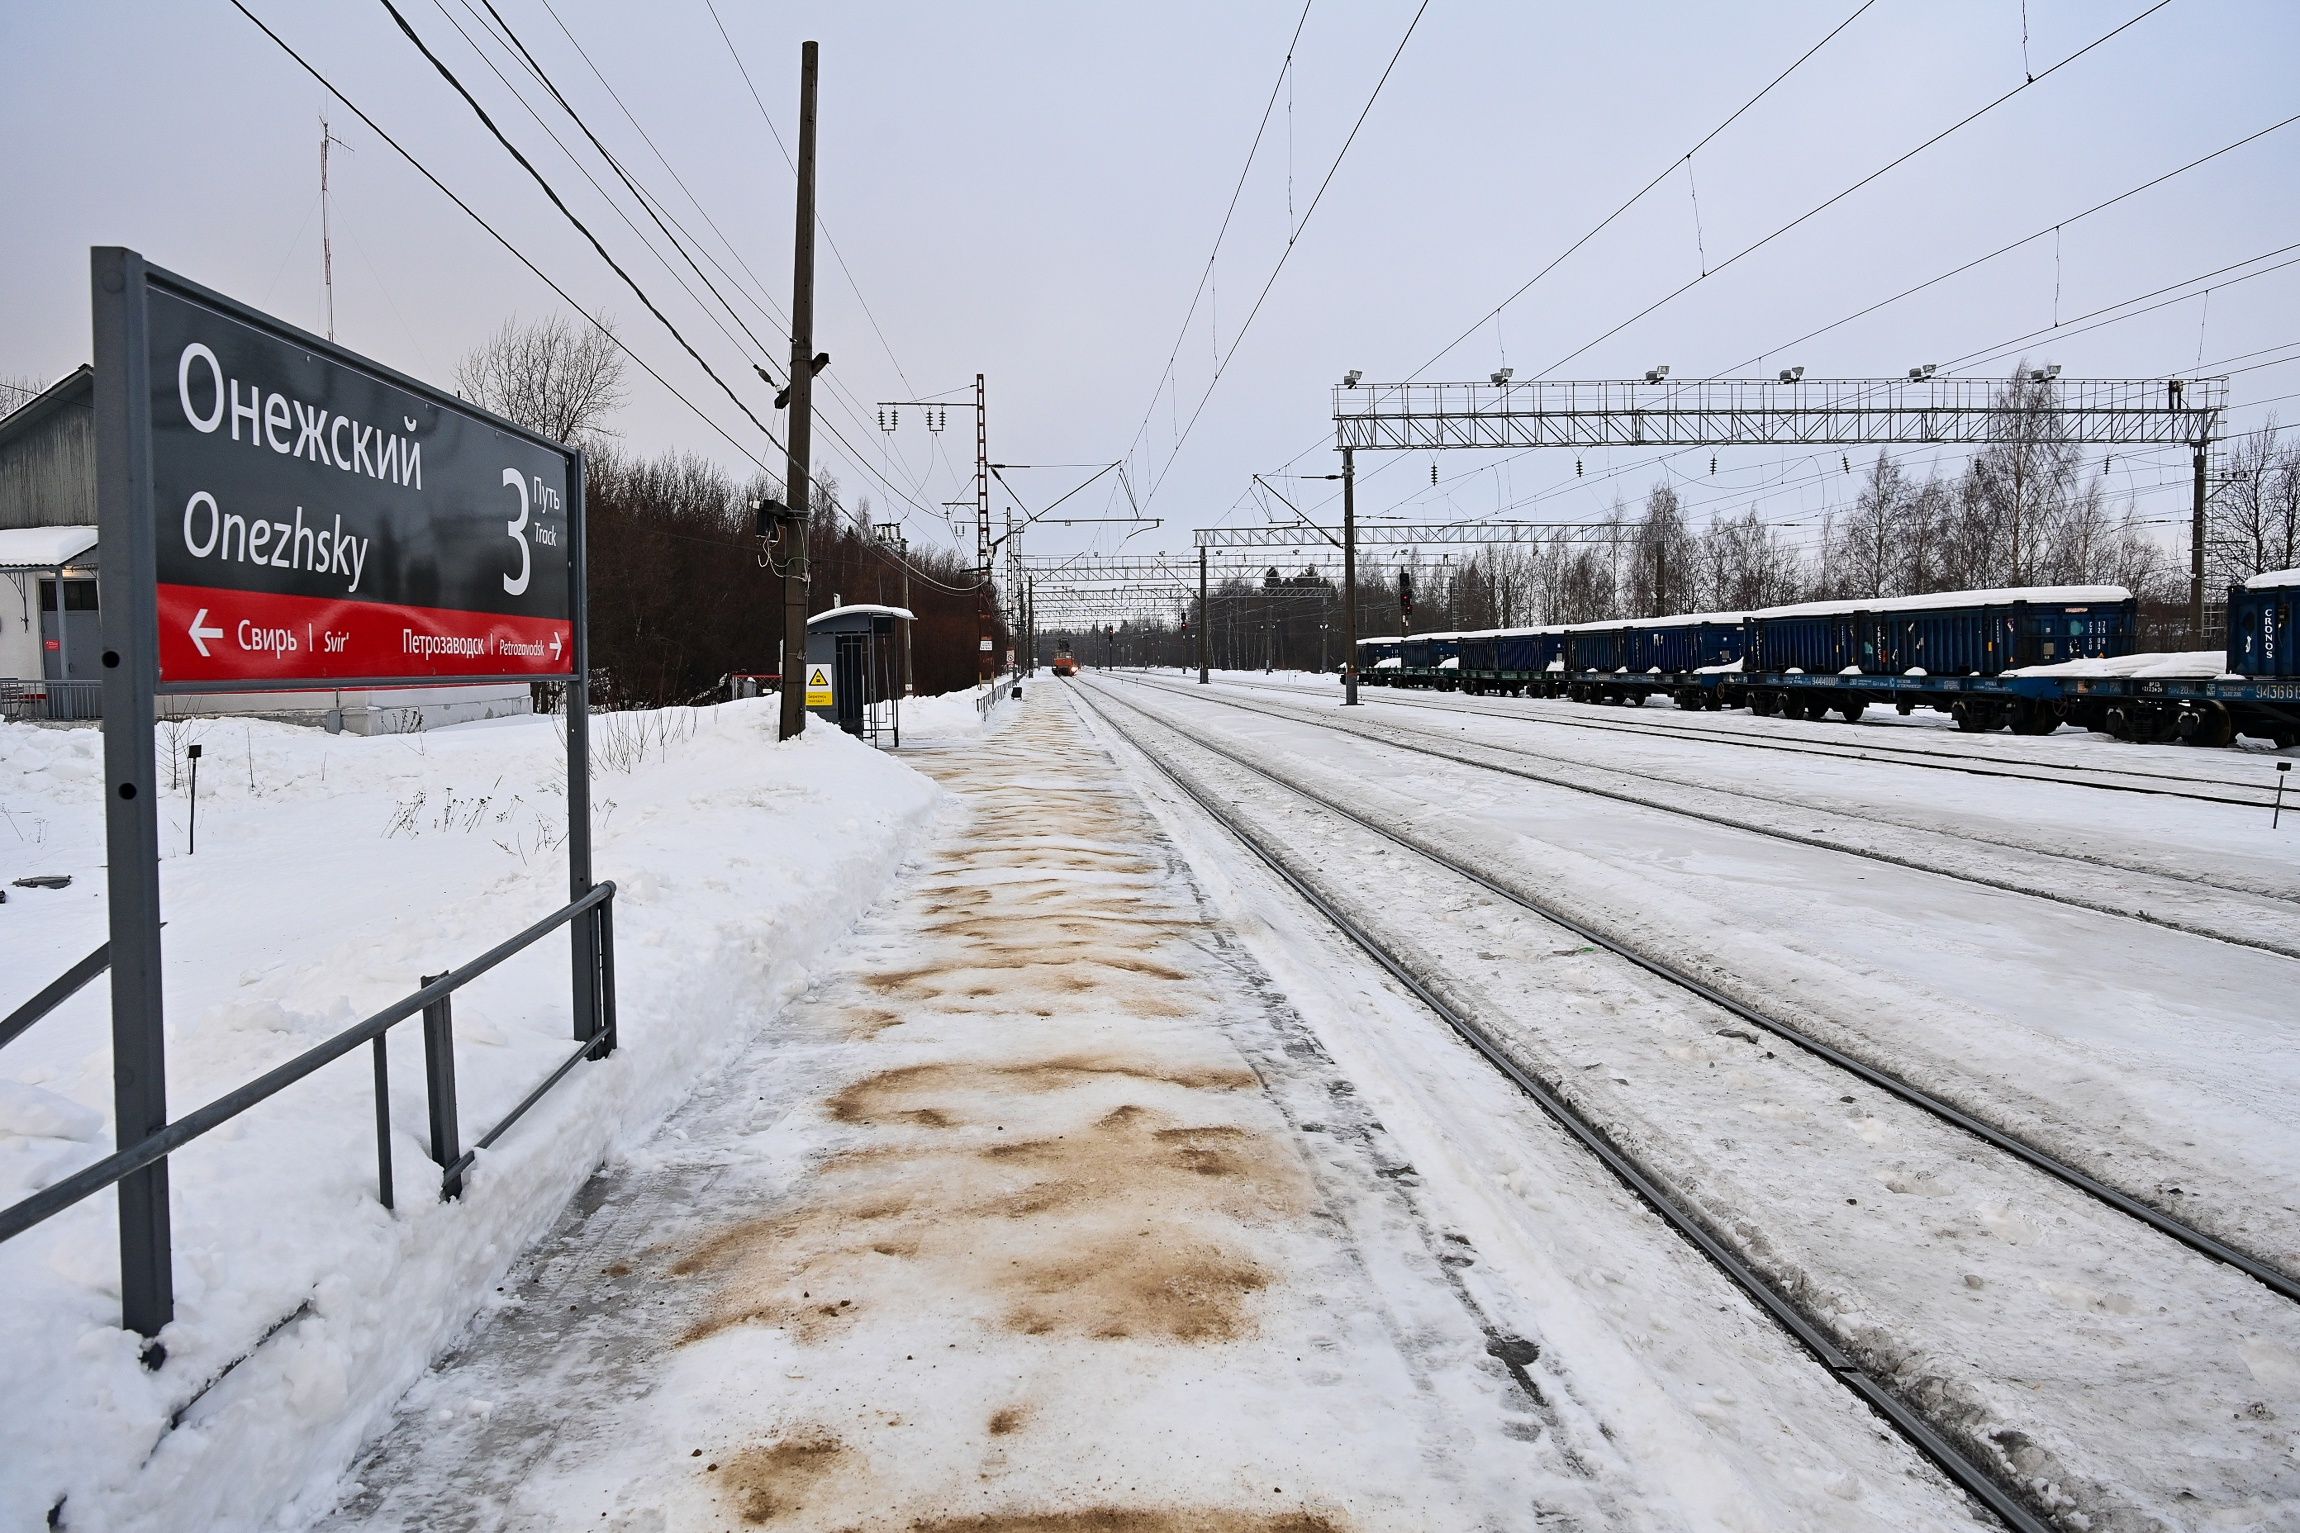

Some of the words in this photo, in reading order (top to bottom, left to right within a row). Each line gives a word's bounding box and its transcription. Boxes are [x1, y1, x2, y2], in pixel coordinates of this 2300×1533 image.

[178, 342, 422, 491] Онежский
[533, 476, 560, 514] Путь
[183, 490, 369, 593] Onezhsky
[502, 467, 531, 596] 3
[534, 522, 557, 547] Track
[237, 619, 298, 659] Свирь
[324, 631, 349, 653] Svir'
[403, 628, 485, 661] Петрозаводск
[499, 639, 545, 657] Petrozavodsk
[2264, 608, 2274, 659] CRONOS
